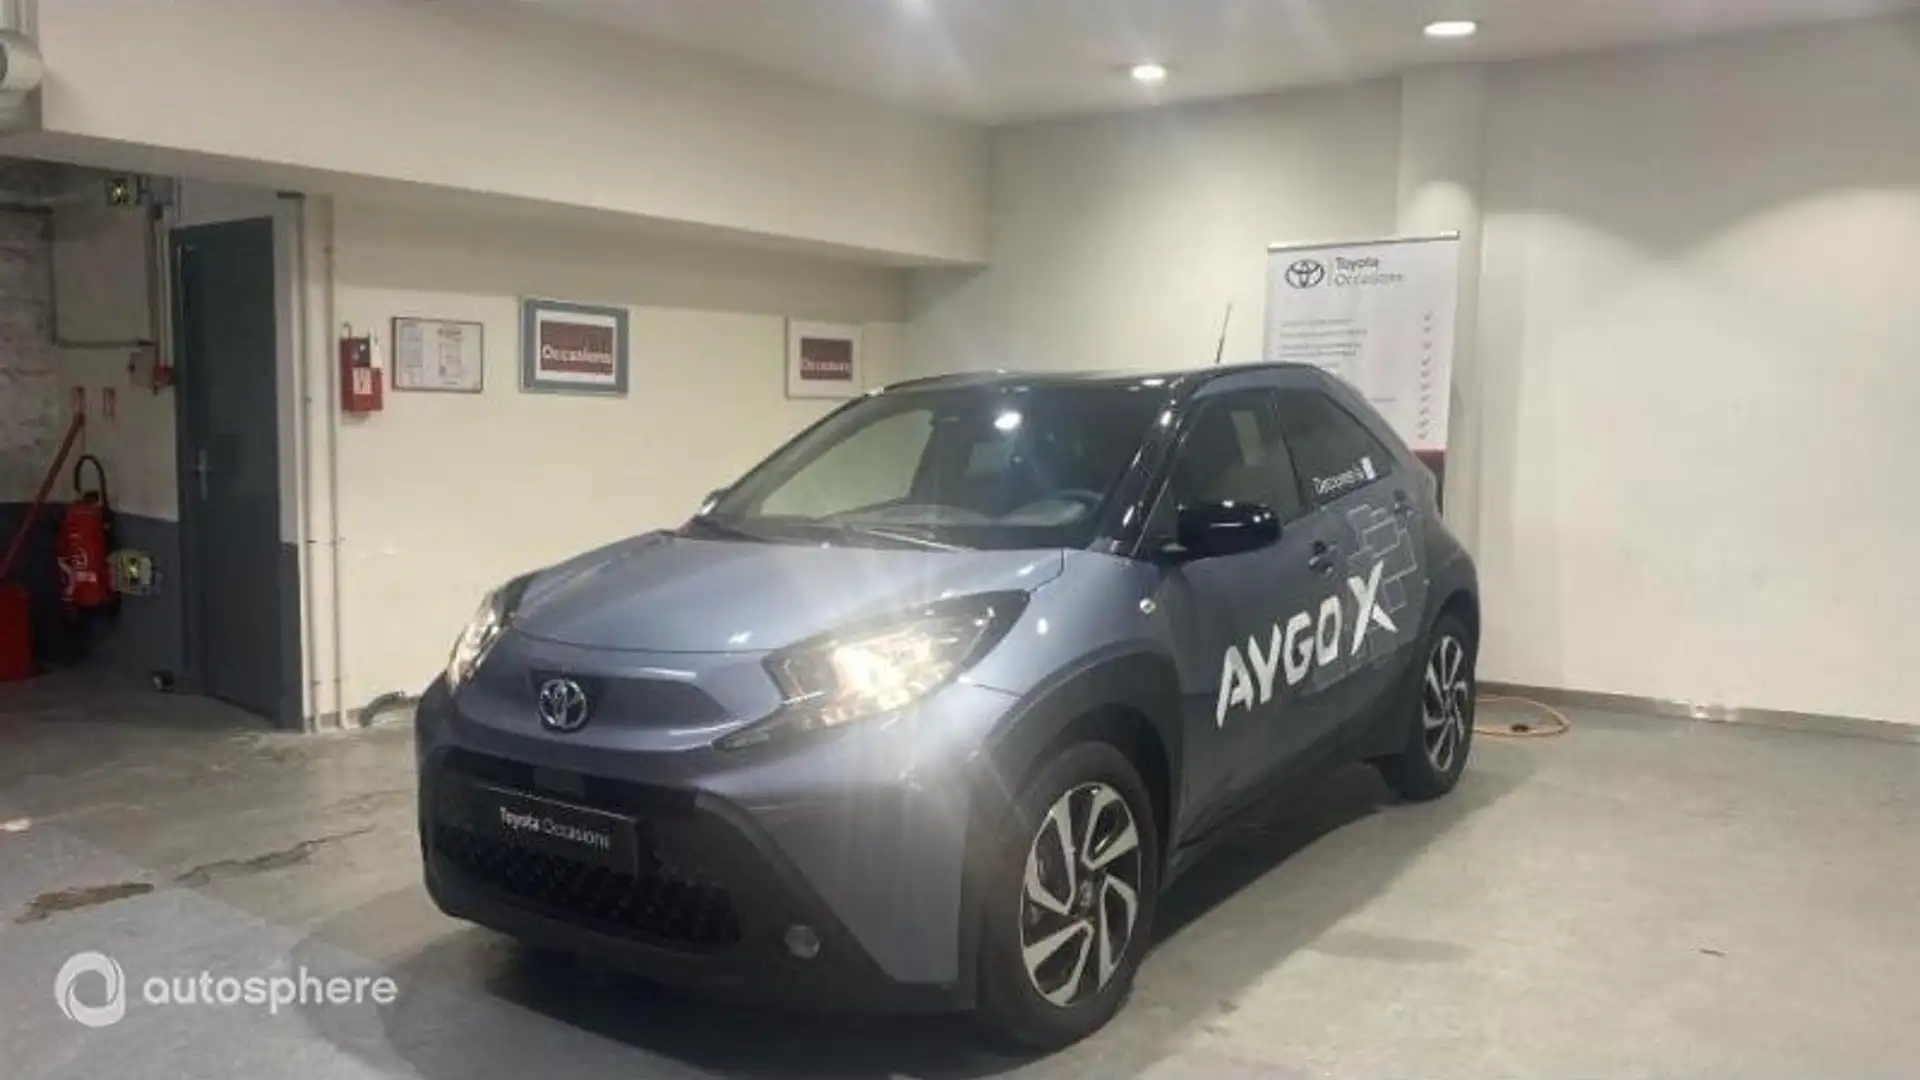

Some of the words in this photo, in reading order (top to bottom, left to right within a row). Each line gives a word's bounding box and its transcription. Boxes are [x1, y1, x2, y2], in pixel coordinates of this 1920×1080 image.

[1215, 595, 1343, 730] AYGO
[1347, 559, 1399, 656] X
[499, 805, 540, 831] Toyota
